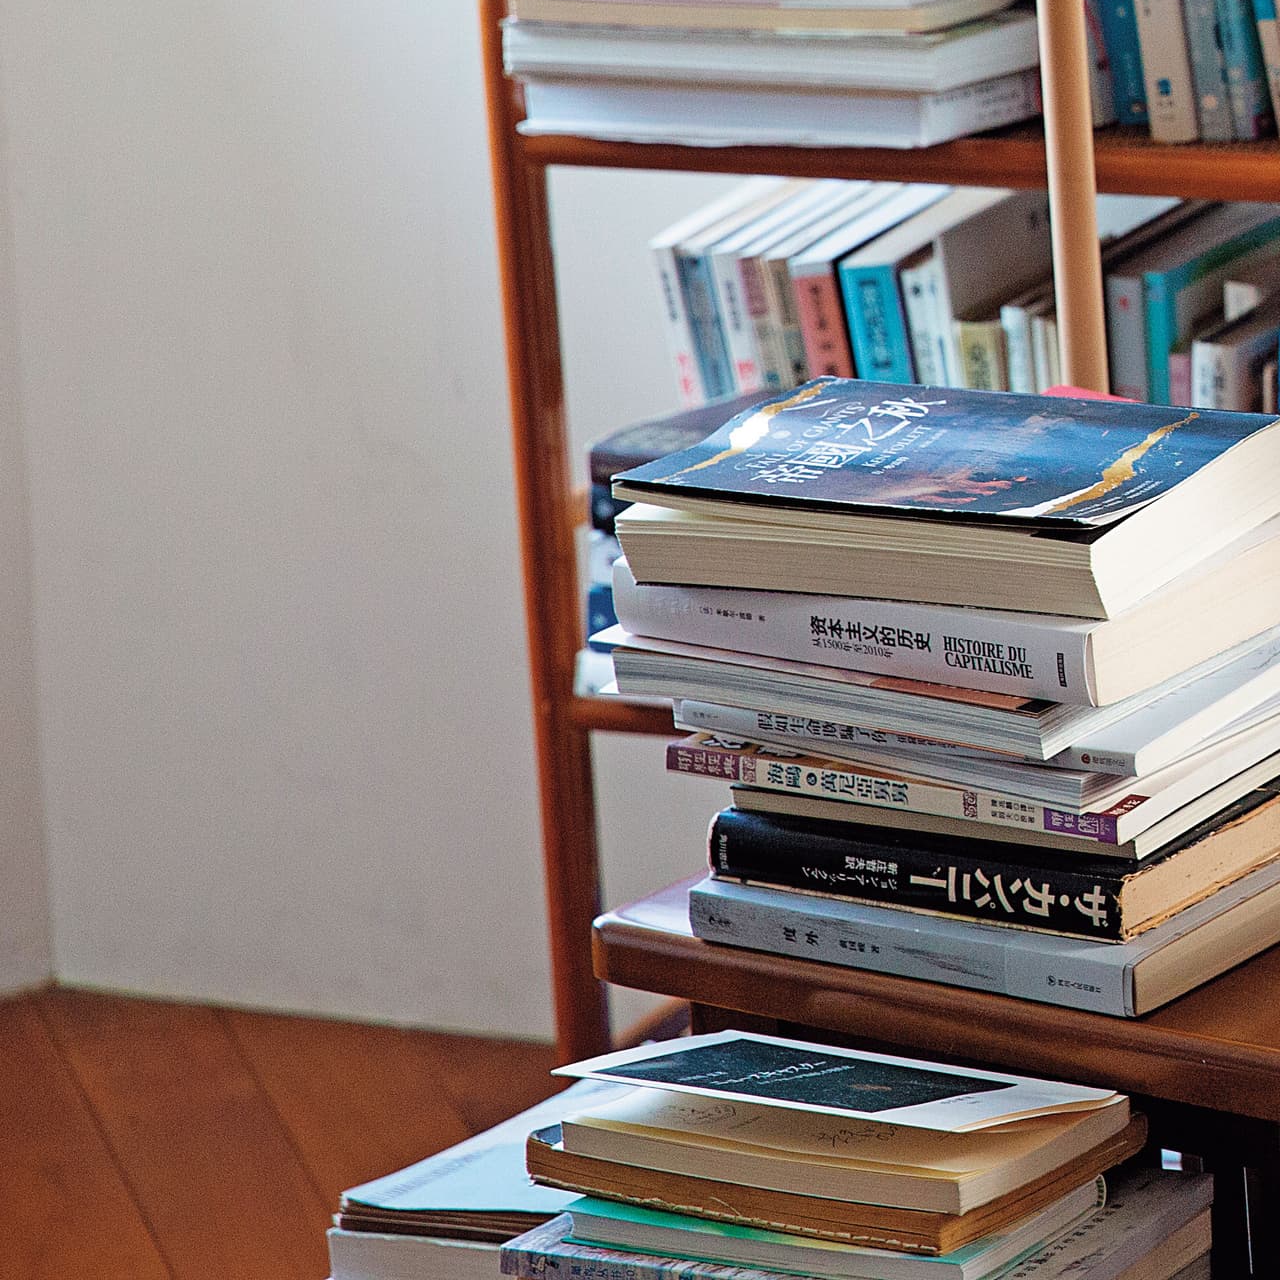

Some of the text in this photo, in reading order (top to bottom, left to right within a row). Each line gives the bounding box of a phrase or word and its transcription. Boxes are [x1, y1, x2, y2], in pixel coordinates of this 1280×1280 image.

[749, 397, 947, 484] 帝國之秋
[810, 615, 932, 653] 资本主义的历史
[812, 637, 893, 658] 从1500年至2010年
[943, 635, 1027, 663] HISTOIRE DU
[944, 652, 1034, 679] CAPITALISME
[757, 712, 888, 744] 假如生命欺騙了你
